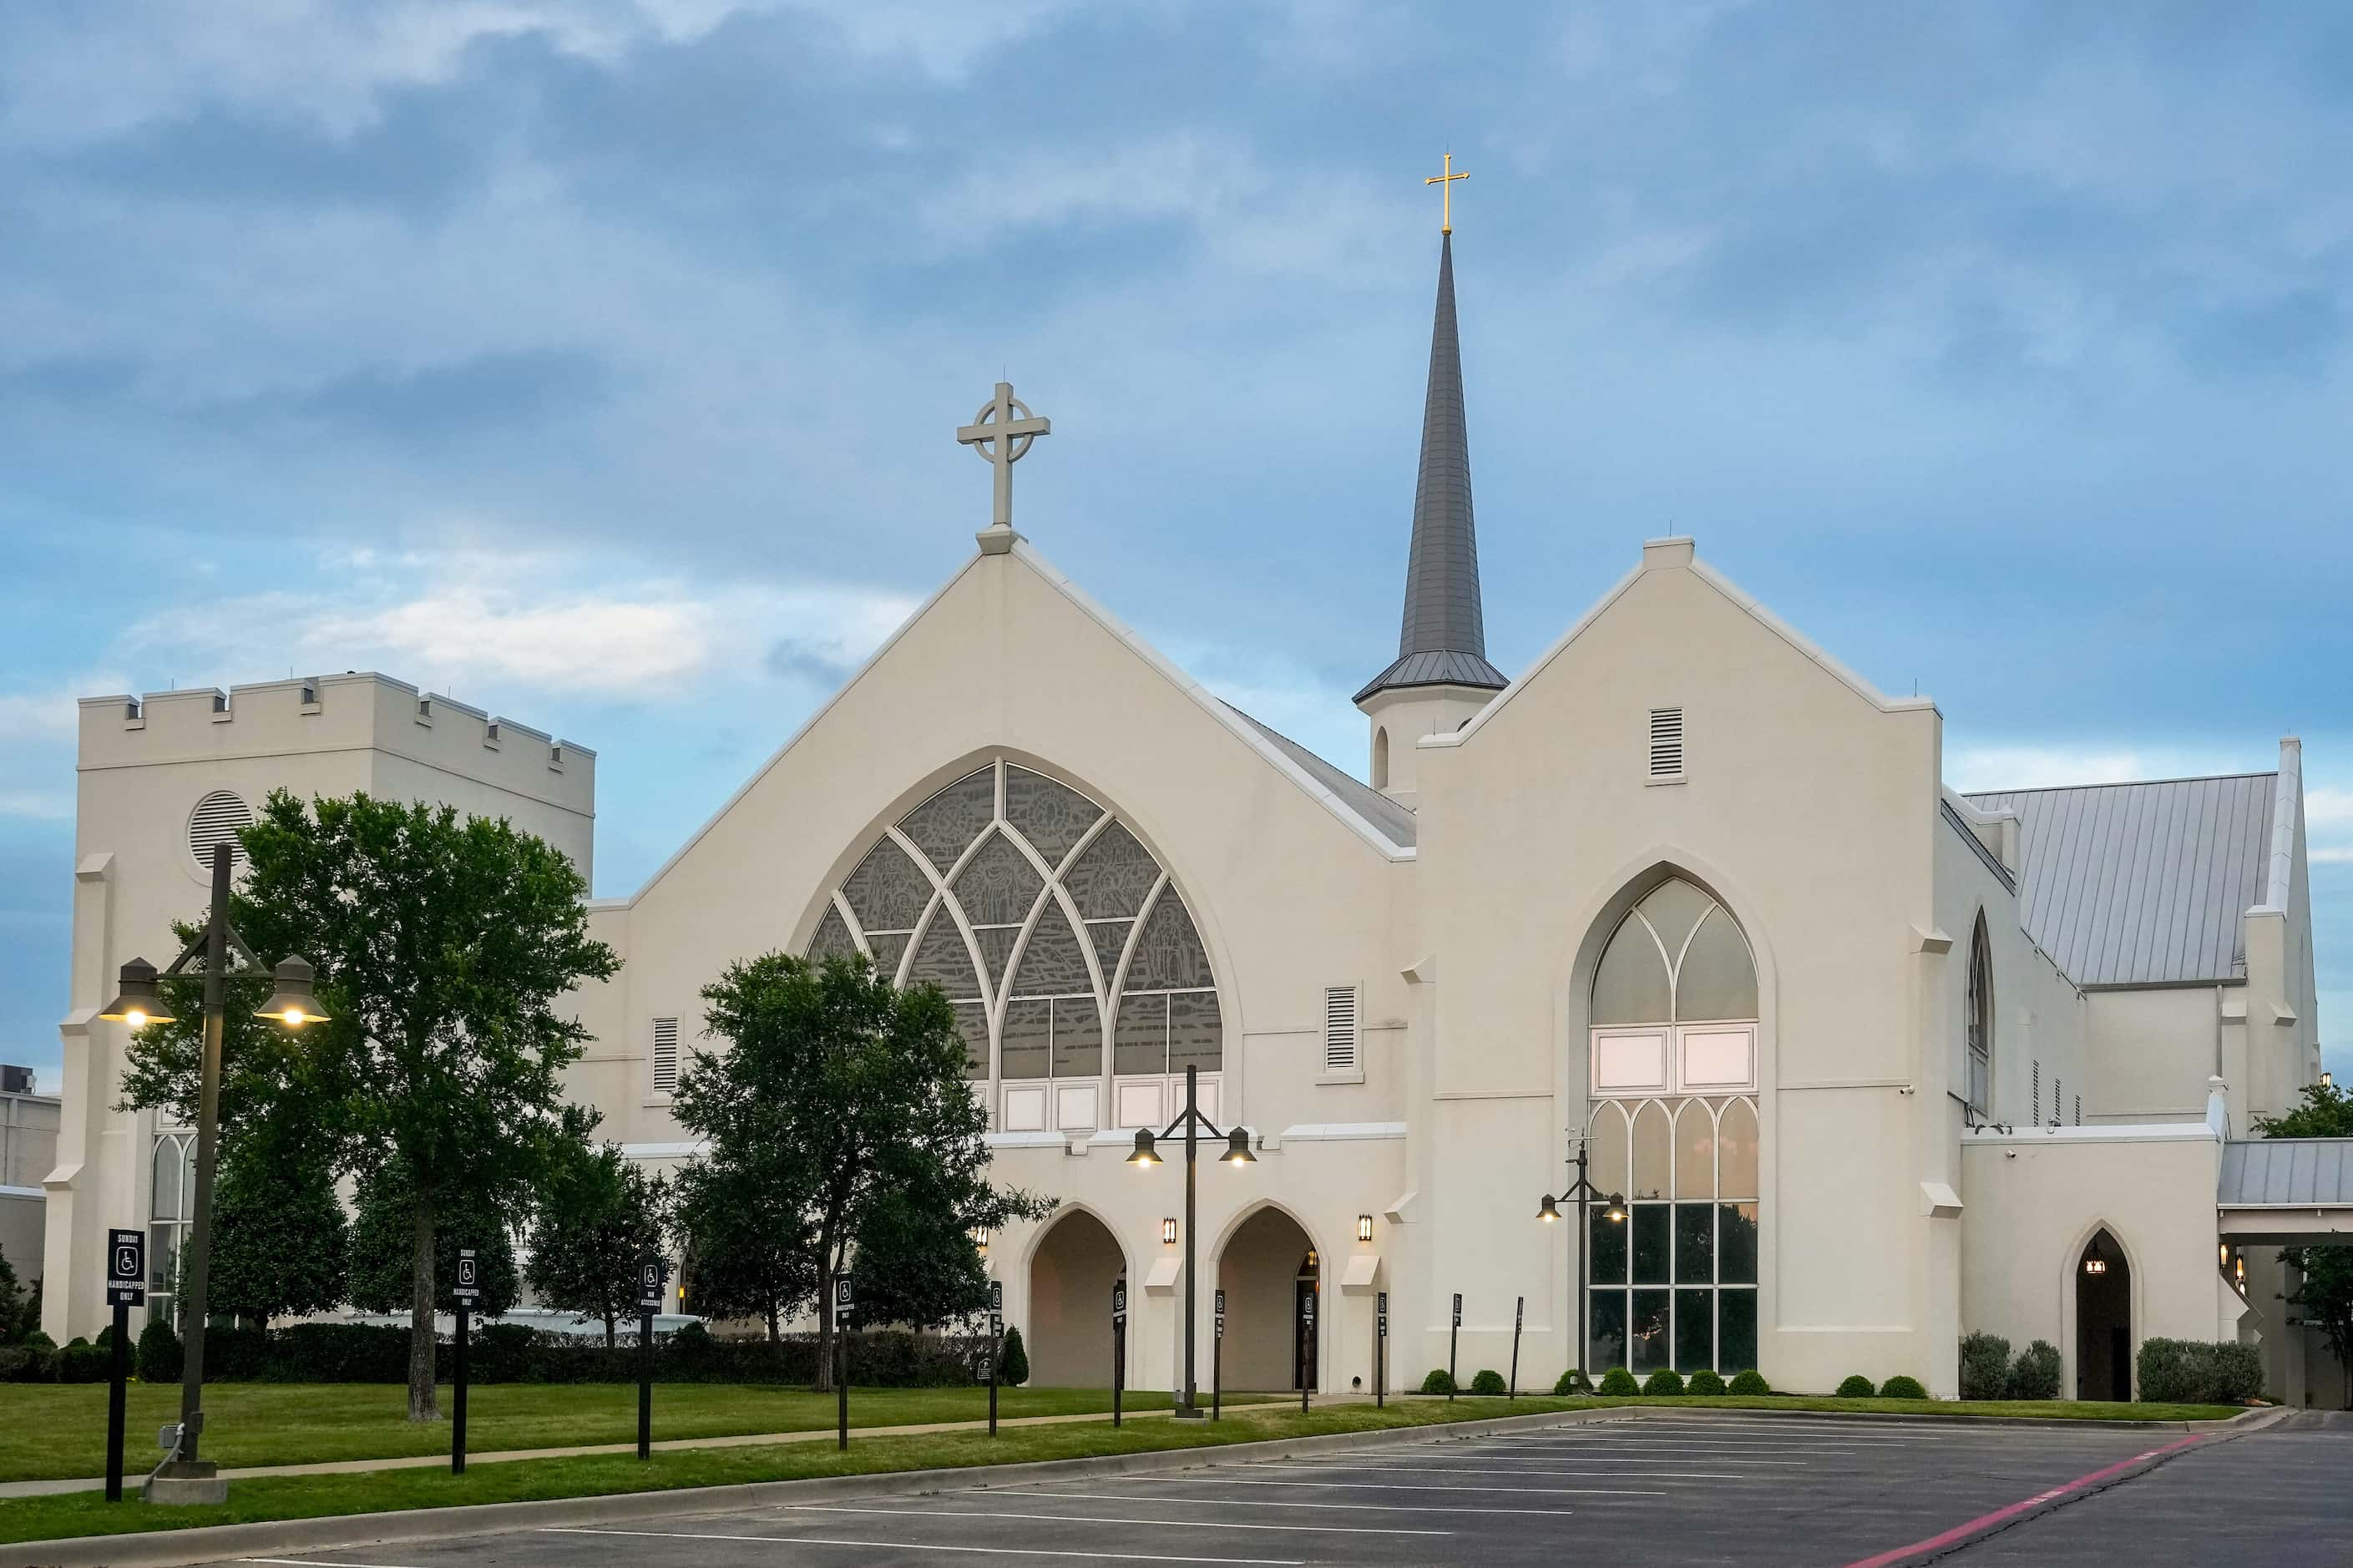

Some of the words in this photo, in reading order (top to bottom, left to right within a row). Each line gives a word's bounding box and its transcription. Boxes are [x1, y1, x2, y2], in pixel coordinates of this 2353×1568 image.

[118, 1234, 139, 1243] SUNDAY
[108, 1280, 144, 1290] HANDICAPPED
[119, 1292, 134, 1301] ONLY
